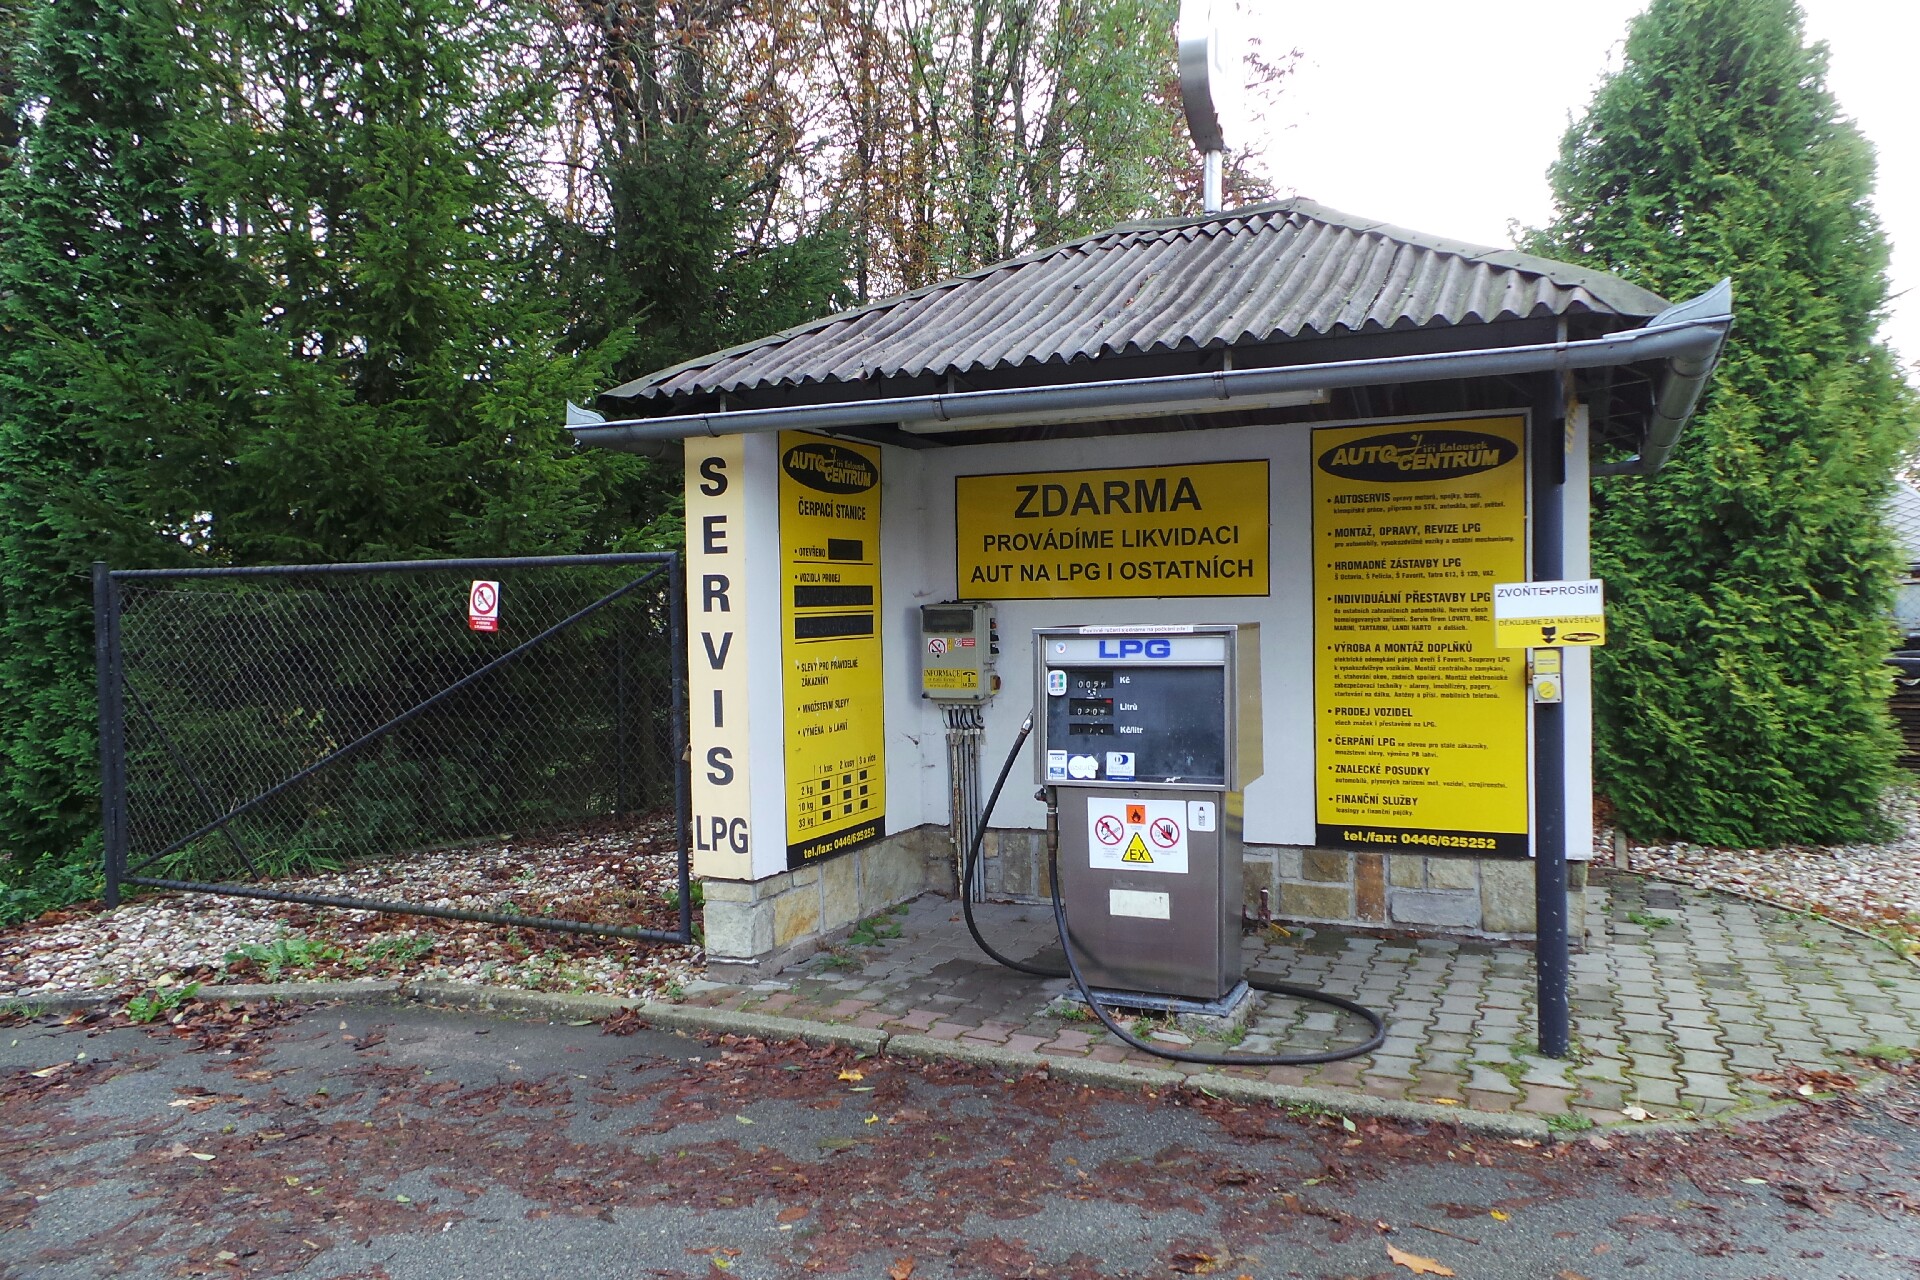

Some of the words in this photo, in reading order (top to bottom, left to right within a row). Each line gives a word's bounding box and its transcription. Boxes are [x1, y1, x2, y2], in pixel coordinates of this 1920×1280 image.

[790, 450, 826, 472] AUTO
[1331, 445, 1399, 466] AUTO
[1400, 449, 1499, 471] CENTRUM
[825, 466, 871, 487] CENTRUM
[1014, 477, 1202, 518] ZDARMA
[1334, 492, 1390, 504] AUTOSERVIS
[798, 496, 834, 517] ČERPACÍ
[836, 504, 866, 520] STANICE
[1380, 526, 1420, 536] OPRAVY,
[1424, 524, 1458, 534] REVIZE
[1462, 523, 1480, 533] LPG
[983, 528, 1114, 552] PROVÁDÍME
[1122, 526, 1239, 548] LIKVIDACI
[799, 546, 825, 557] OTEVŘENO
[971, 565, 1013, 583] AUT
[1020, 564, 1050, 582] NA
[1057, 563, 1100, 581] LPG
[1107, 563, 1112, 580] I
[1120, 555, 1252, 580] OSTATNÍCH
[1335, 558, 1386, 570] HROMADNÉ
[1390, 557, 1439, 568] ZÁSTAVBY
[1443, 558, 1461, 568] LPG
[800, 573, 820, 582] VOZIDLA
[822, 574, 840, 582] PRODEJ
[1334, 591, 1401, 603] INDIVIDUÁLNÍ
[1406, 590, 1466, 603] PŘESTAVBY
[1471, 592, 1491, 602] LPG
[1498, 586, 1546, 597] ZVOŇTE
[1551, 583, 1598, 595] PROSÍM
[699, 456, 734, 786] SERVIS
[1099, 640, 1170, 658] LPG
[1334, 641, 1371, 652] VÝROBA
[1375, 644, 1380, 652] A
[1385, 641, 1424, 652] MONTÁŽ
[1428, 641, 1472, 652] DOPLŇKŮ
[802, 662, 818, 672] SLEVY
[819, 662, 828, 670] PRO
[831, 657, 858, 670] PRAVIDELNÉ
[802, 674, 829, 687] ZÁKAZNÍKY
[803, 698, 833, 713] MNOŽSTEVNÍ
[835, 698, 849, 708] SLEVY
[1335, 707, 1370, 716] PRODEJ
[1374, 708, 1413, 717] VOZIDEL
[803, 724, 824, 737] VÝMĚNA
[1335, 734, 1375, 746] ČERPÁNÍ
[1378, 738, 1396, 746] LPG
[868, 754, 876, 762] více
[844, 760, 855, 770] kusy
[1335, 763, 1381, 774] ZNALECKÉ
[1385, 766, 1430, 776] POSUDKY
[801, 786, 804, 795] 2
[807, 786, 813, 795] kg
[1336, 793, 1379, 804] FINANČNÍ
[1383, 794, 1418, 806] SLUŽBY
[799, 802, 805, 812] 10
[807, 802, 813, 810] kg
[799, 818, 805, 828] 33
[808, 818, 813, 826] kg
[696, 815, 748, 854] LPG
[1344, 831, 1398, 843] tel./fax:
[1401, 834, 1496, 849] 0446/625252
[804, 842, 832, 859] tel./fax:
[834, 827, 875, 850] 0446/625252
[1130, 849, 1145, 861] EX
